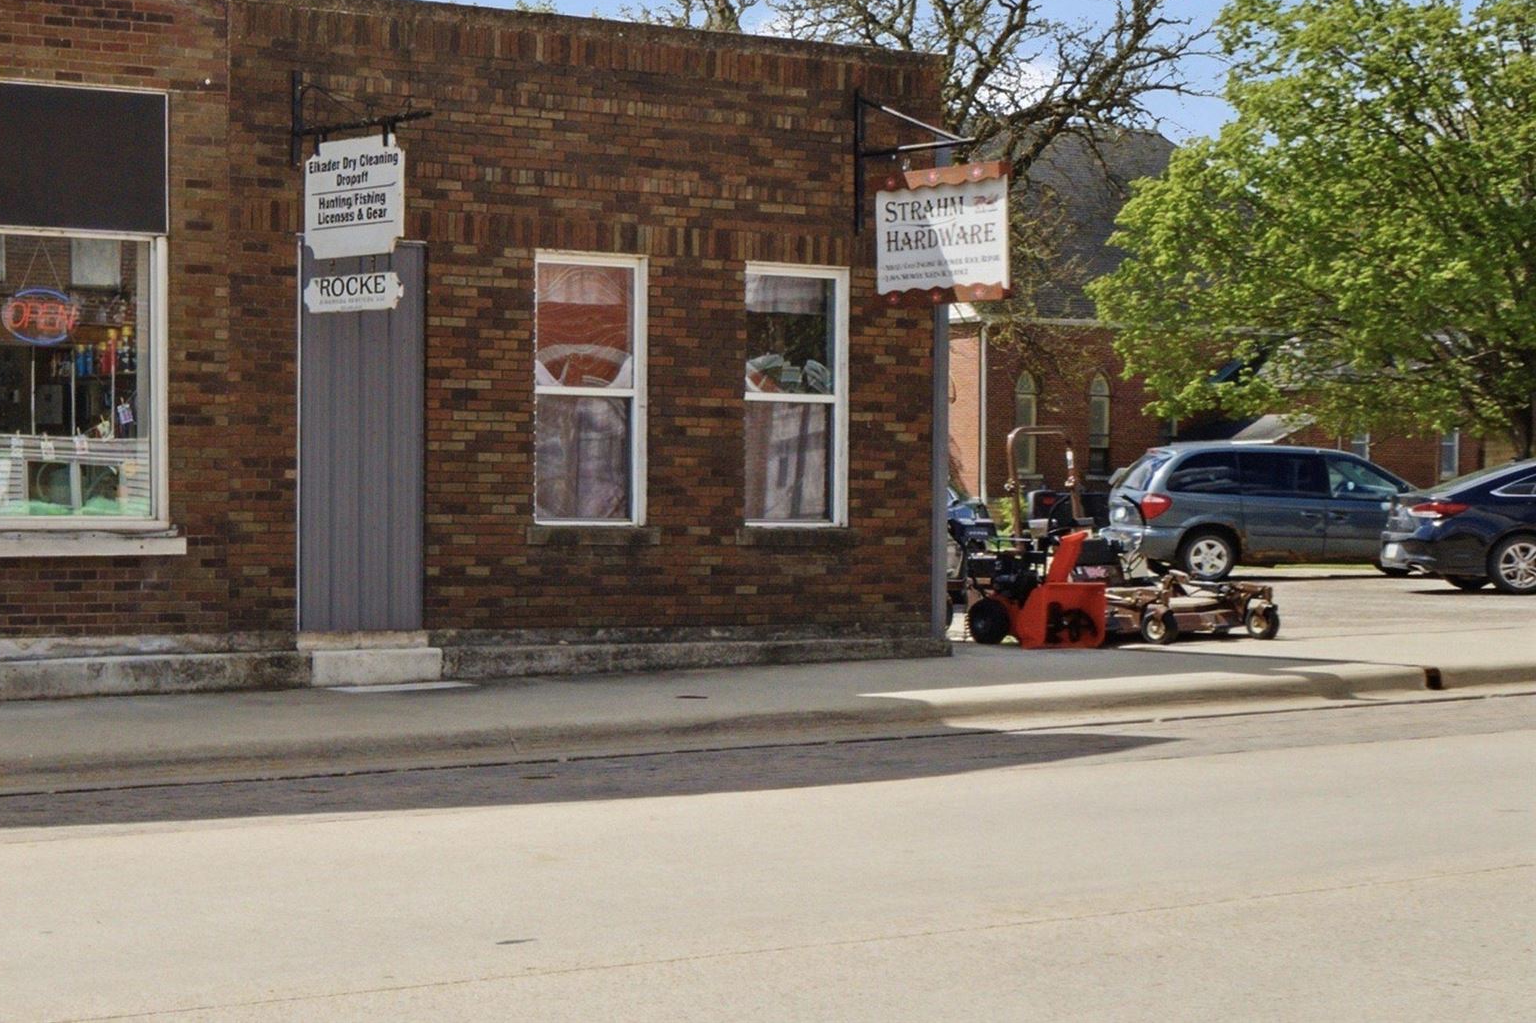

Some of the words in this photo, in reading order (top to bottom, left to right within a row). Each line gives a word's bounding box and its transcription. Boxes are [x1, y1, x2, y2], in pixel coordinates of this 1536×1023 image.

[343, 157, 356, 171] Dry
[360, 152, 399, 166] Cleaning
[318, 211, 355, 225] Licenses
[357, 208, 364, 221] &
[366, 207, 388, 220] Gear
[885, 196, 964, 223] STRAHM
[886, 223, 996, 252] HARDWARE
[320, 275, 385, 297] ROCKE
[9, 301, 78, 331] OPEN
